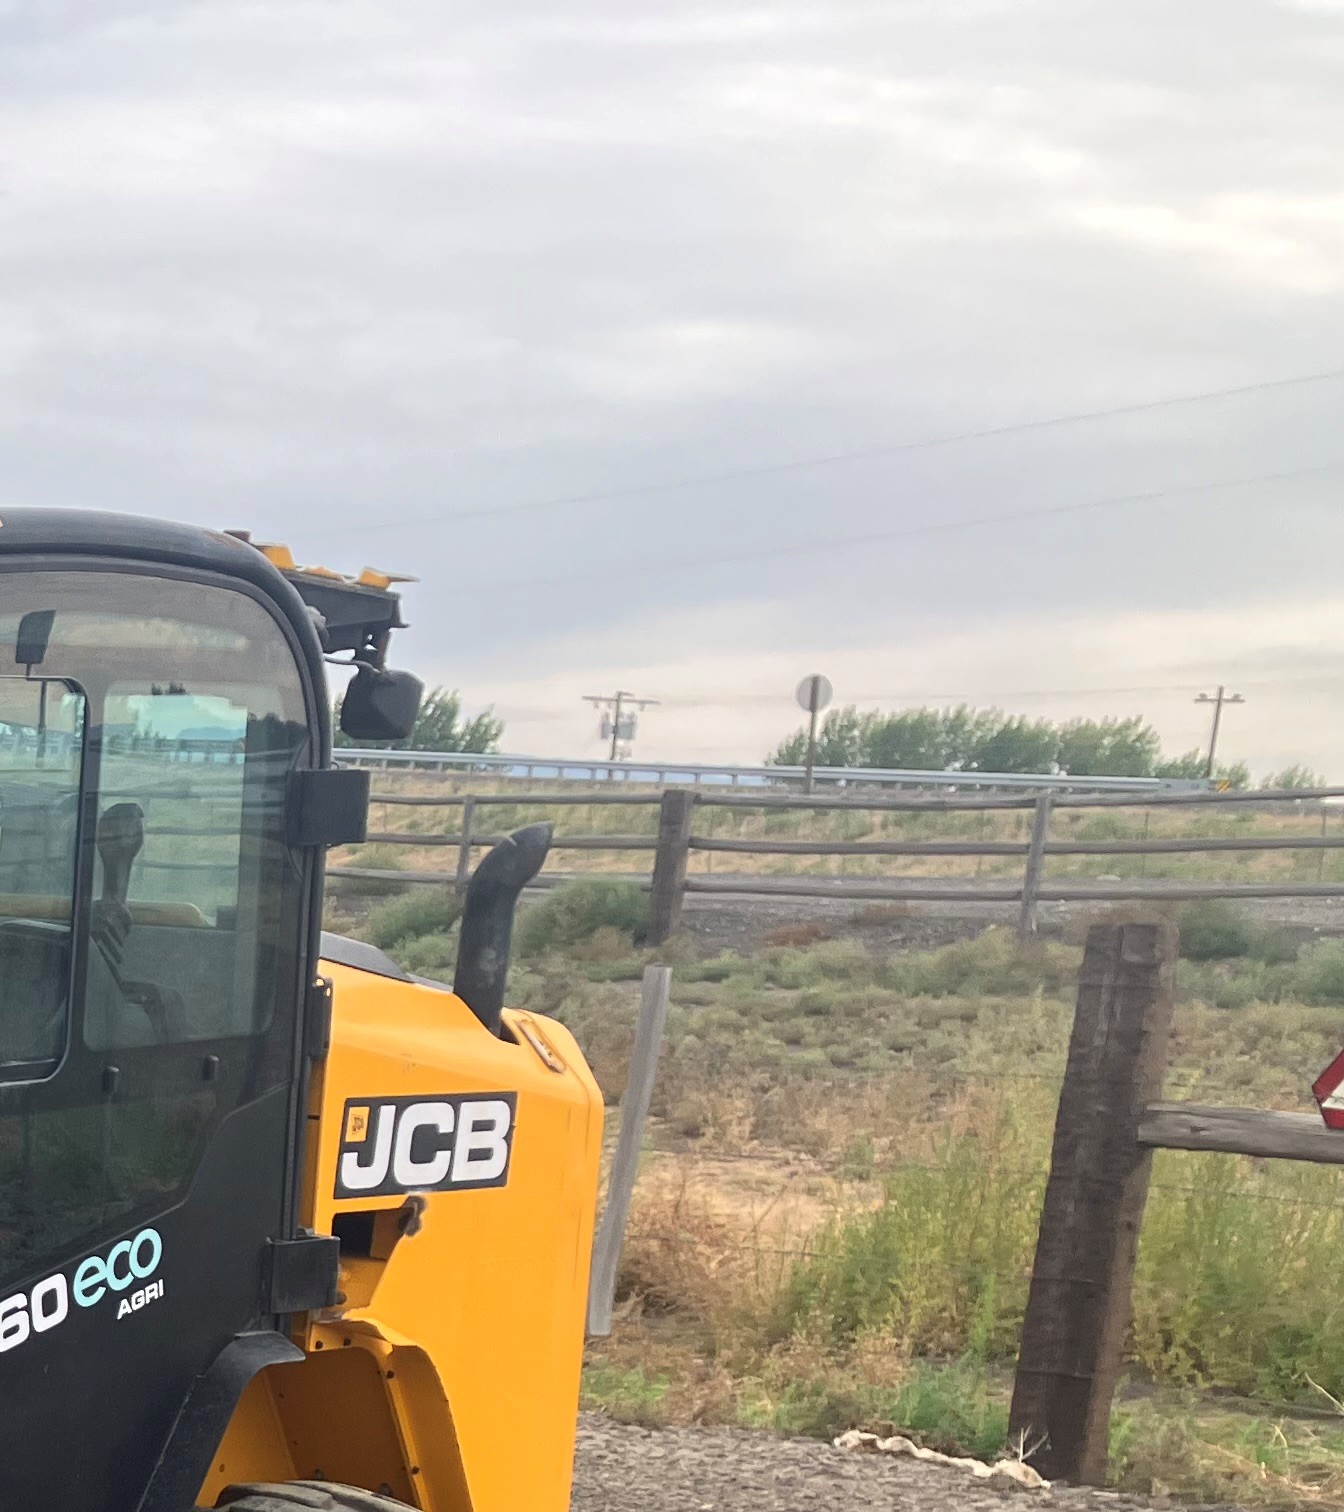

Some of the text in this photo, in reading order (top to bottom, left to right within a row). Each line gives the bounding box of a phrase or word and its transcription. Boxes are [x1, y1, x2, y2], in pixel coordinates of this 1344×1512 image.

[341, 1101, 511, 1189] JCB
[73, 1228, 162, 1308] eco
[117, 1278, 164, 1320] AGRI
